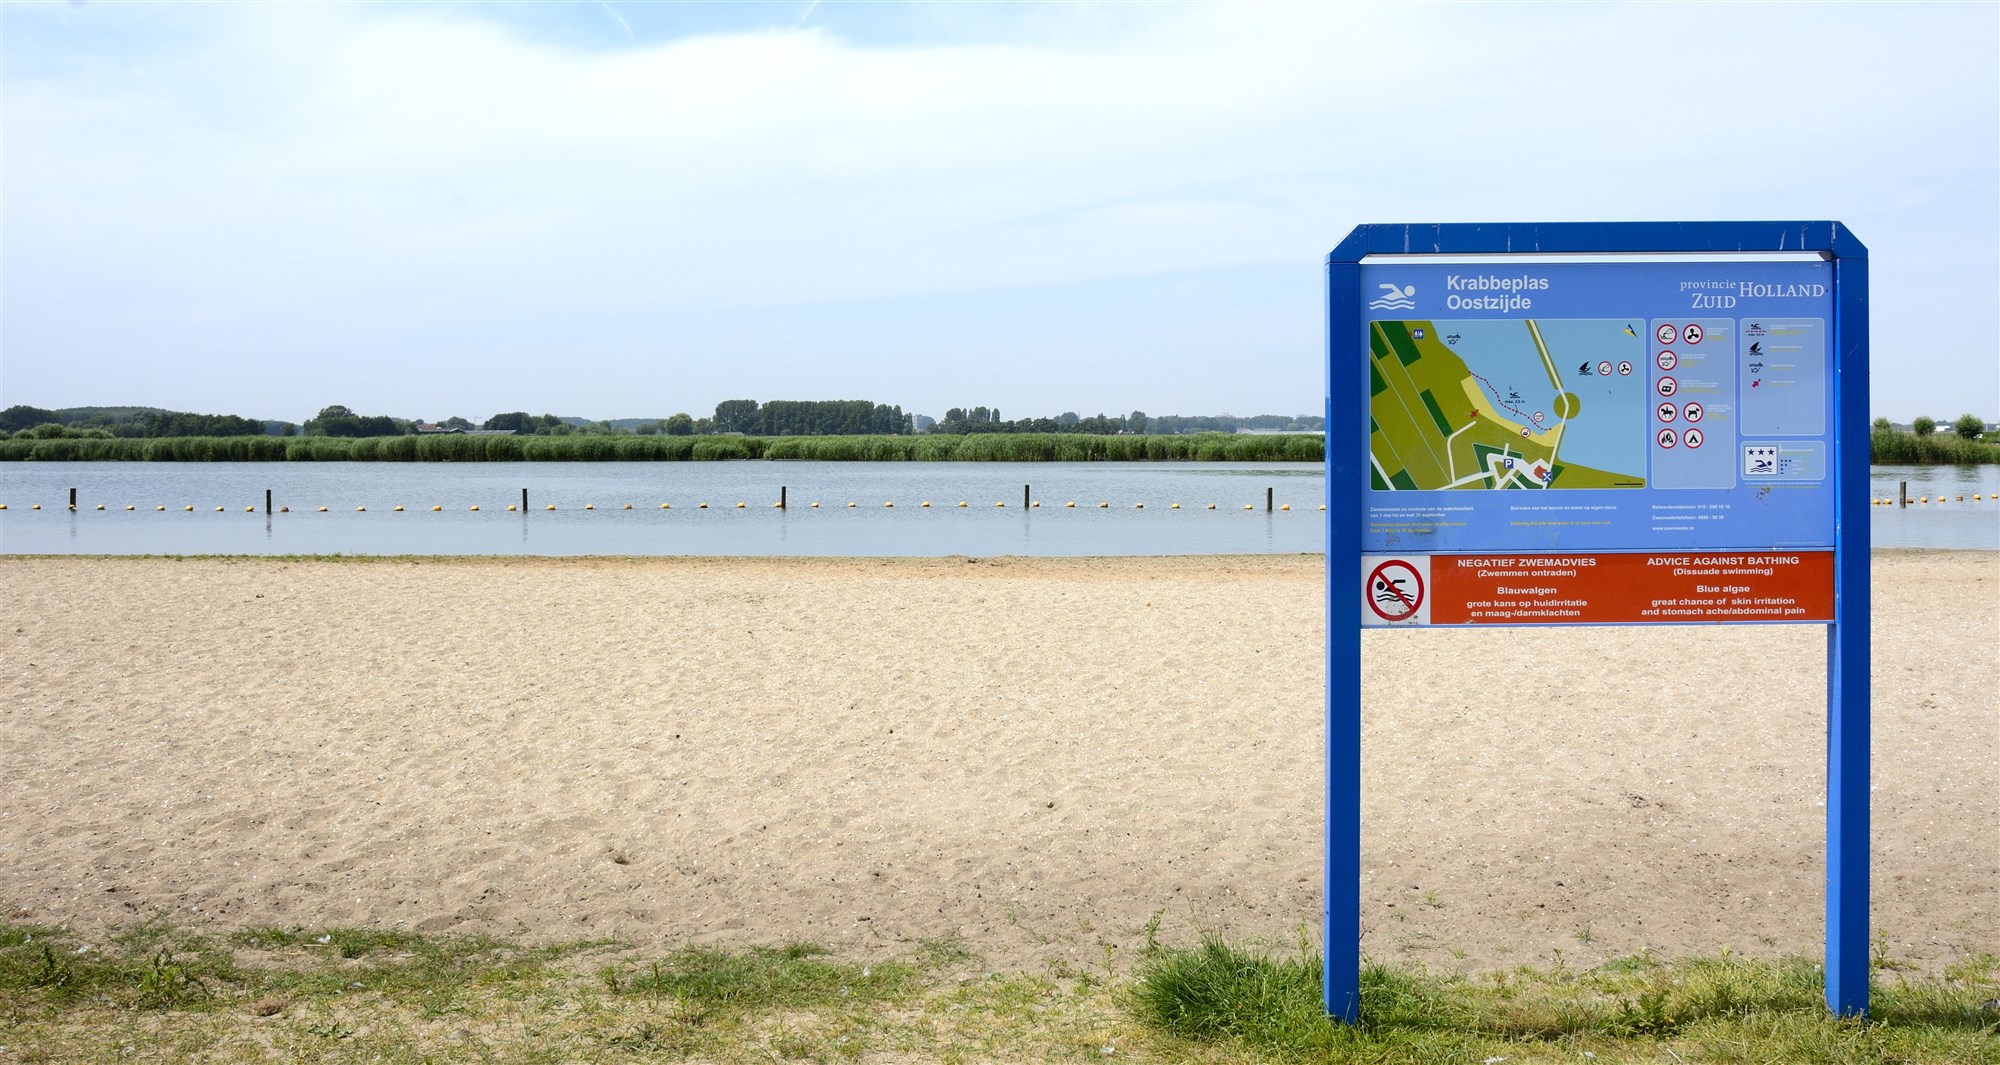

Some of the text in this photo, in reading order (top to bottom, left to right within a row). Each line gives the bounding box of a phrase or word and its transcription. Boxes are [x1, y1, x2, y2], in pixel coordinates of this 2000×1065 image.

[1447, 275, 1549, 293] Krabbeplas
[1680, 279, 1736, 292] provincie
[1691, 282, 1824, 308] ZUID HOLLAND
[1447, 295, 1531, 313] Oostzijde
[1505, 460, 1512, 468] P
[1457, 558, 1596, 567] NEGATIEF ZWEMADVIES
[1647, 556, 1799, 566] ADVICE AGAINST BATHING
[1477, 569, 1576, 578] (Zwemmen ontraden)
[1673, 567, 1773, 576] (Dissuade swimming)
[1497, 587, 1557, 596] Blauwalgen
[1722, 585, 1750, 594] algae
[1466, 601, 1492, 609] grote
[1652, 598, 1676, 607] great
[1485, 610, 1580, 618] maag-/darmklachten
[1642, 608, 1660, 616] and
[1784, 607, 1805, 615] pain
